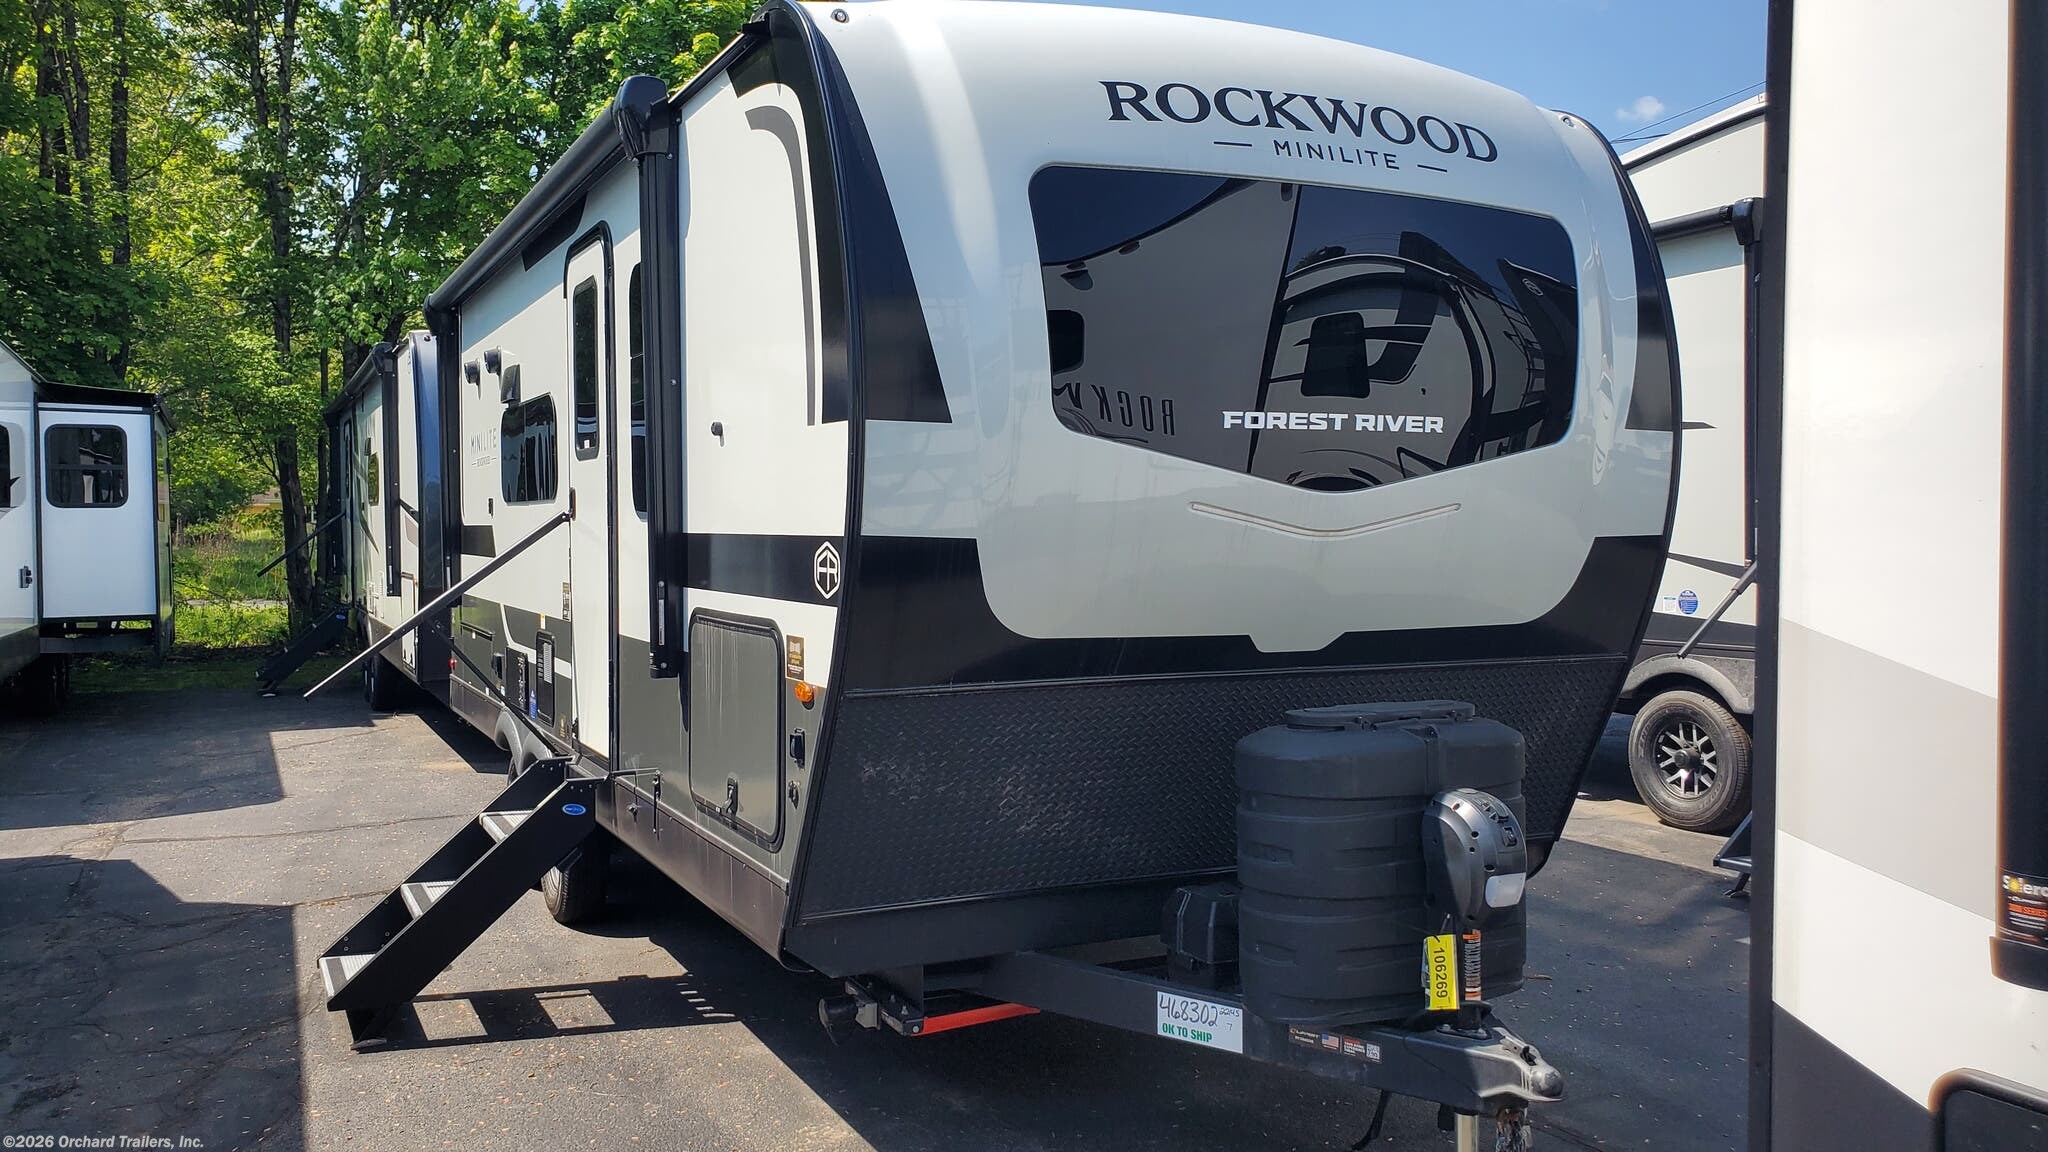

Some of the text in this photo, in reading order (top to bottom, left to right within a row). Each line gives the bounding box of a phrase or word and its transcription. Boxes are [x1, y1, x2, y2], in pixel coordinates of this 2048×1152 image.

[1098, 80, 1498, 163] ROCKWOOD
[1272, 139, 1400, 170] MINILITE
[1222, 411, 1444, 433] FOREST RIVER
[1433, 947, 1448, 999] 106269
[1159, 994, 1218, 1027] 468302
[1162, 1022, 1213, 1043] OK TO SHIP
